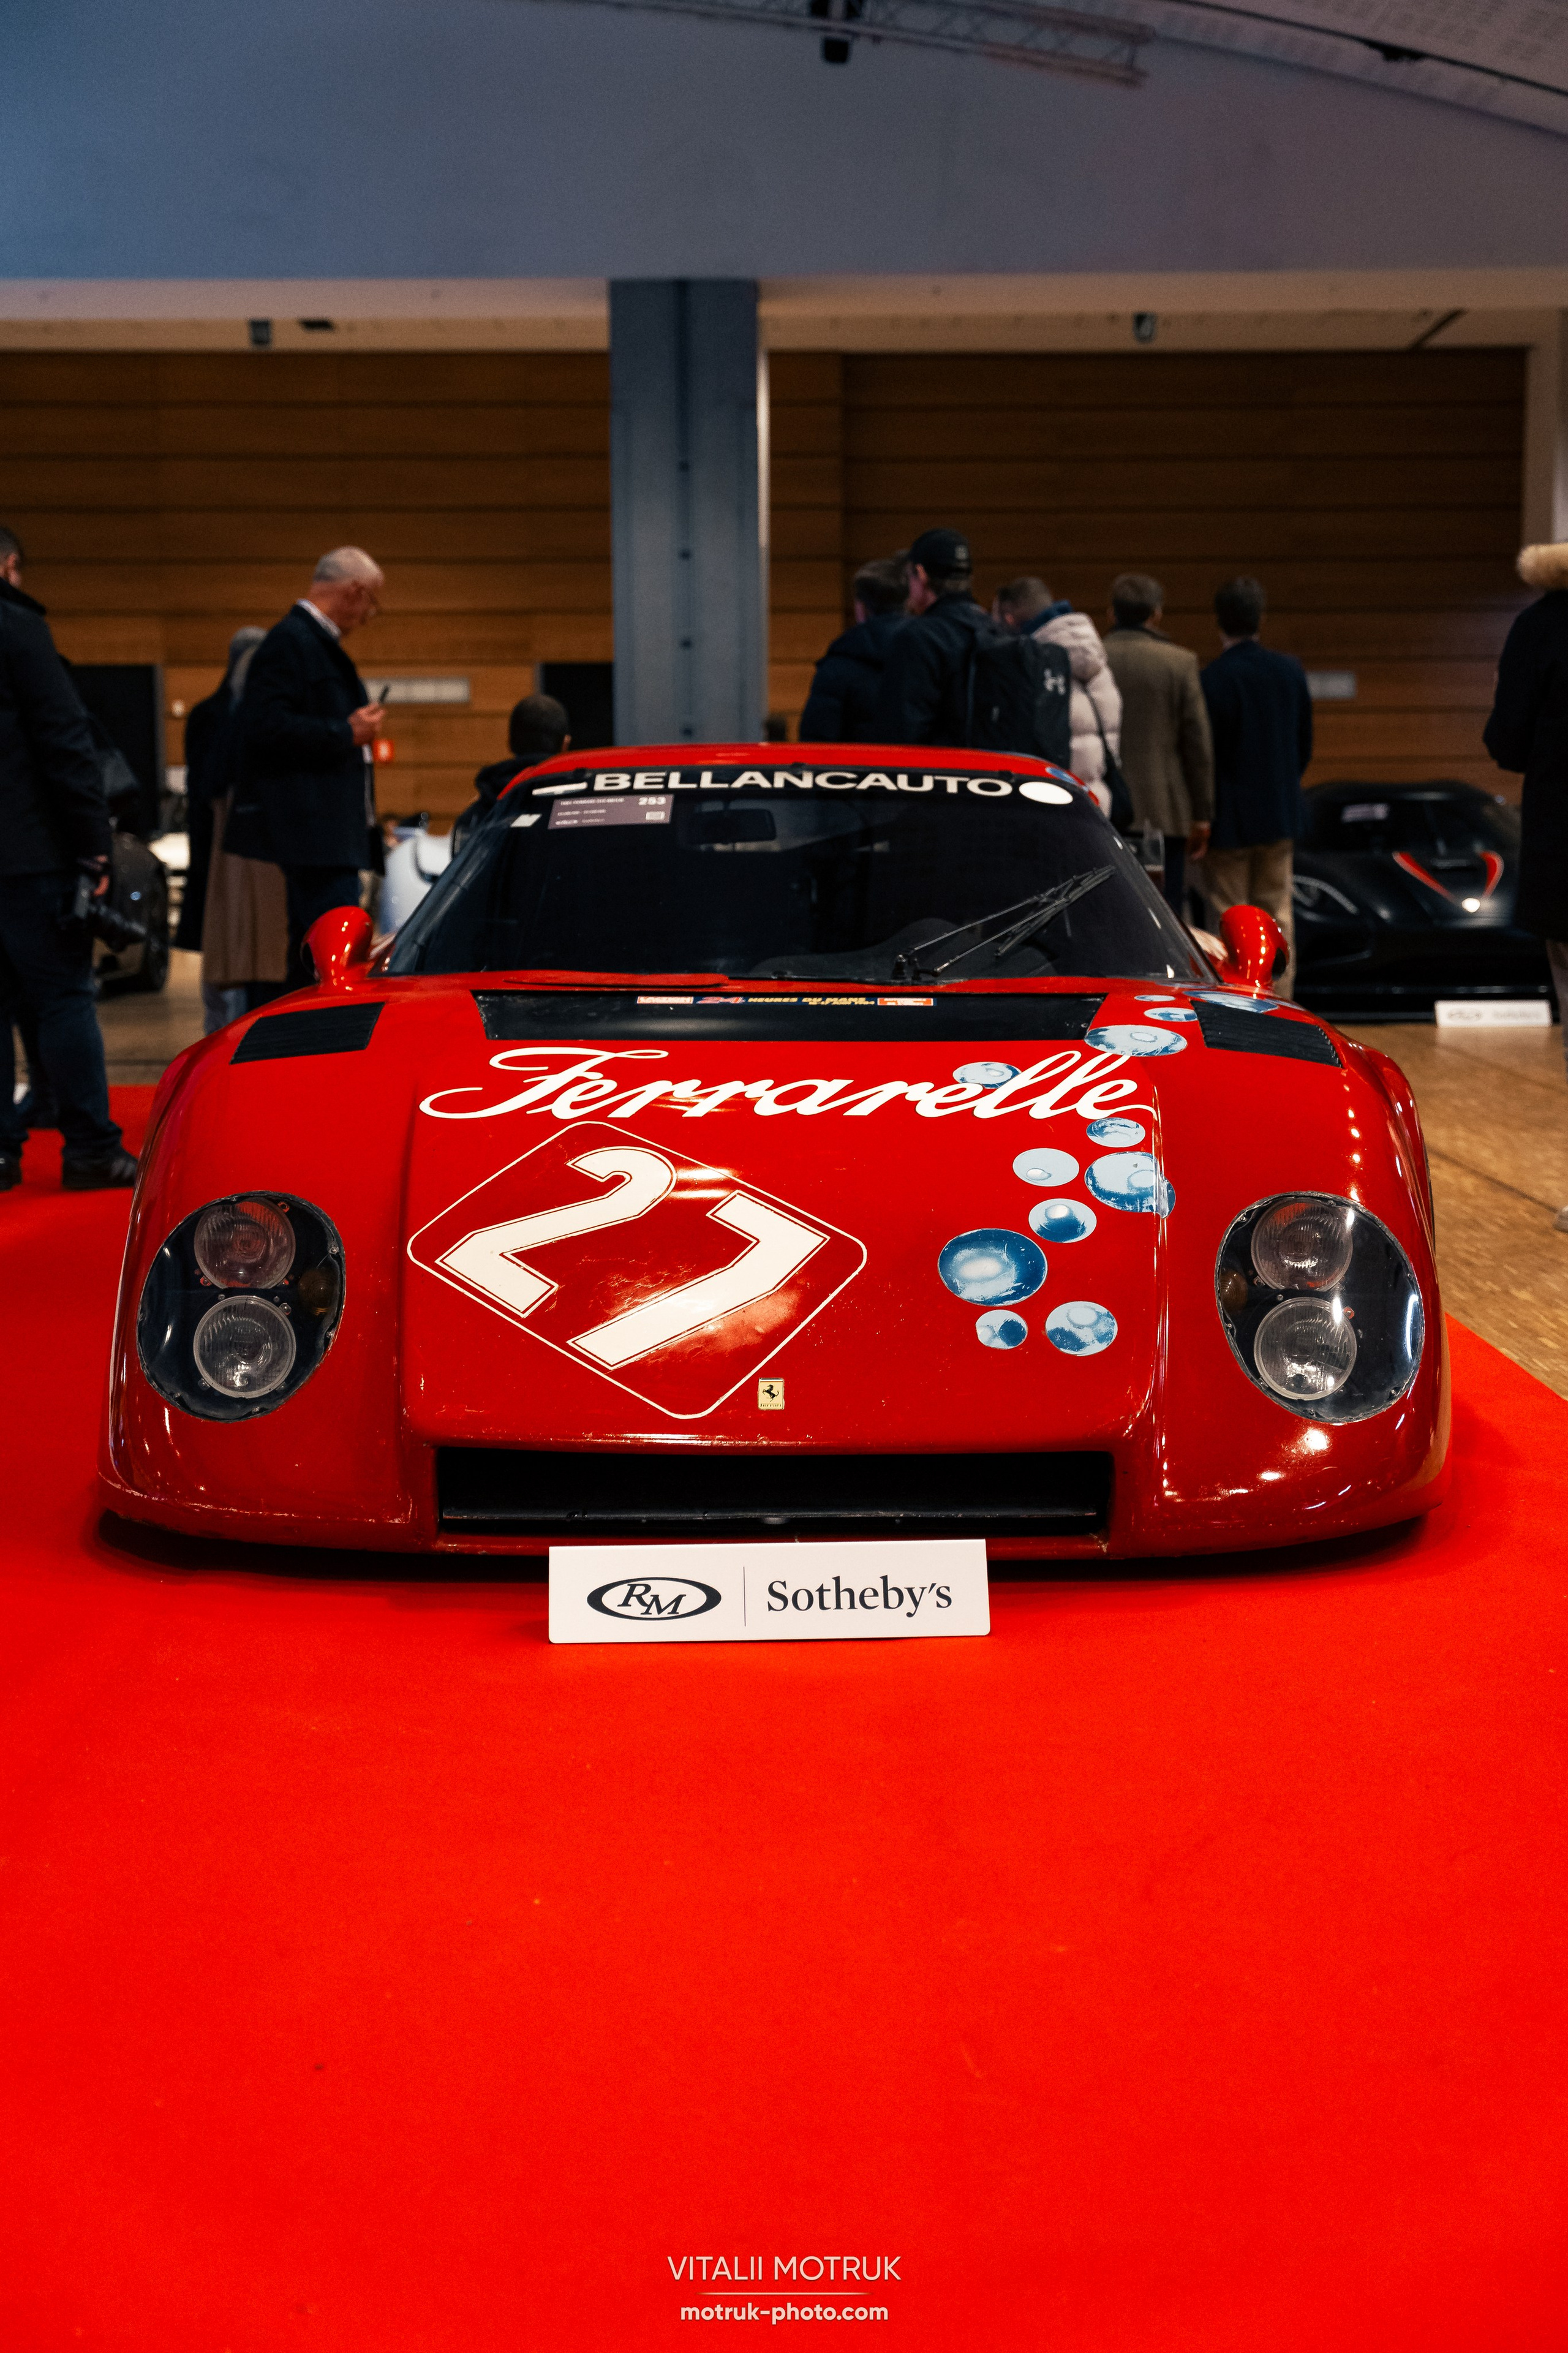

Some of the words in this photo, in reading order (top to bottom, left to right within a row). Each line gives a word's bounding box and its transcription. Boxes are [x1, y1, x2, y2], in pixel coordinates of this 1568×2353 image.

[593, 770, 1013, 796] BELLANCAUTO
[638, 796, 666, 806] 253
[419, 1046, 1158, 1121] Ferrarelle
[434, 1144, 831, 1371] 27
[617, 1583, 687, 1616] RM
[767, 1574, 953, 1618] Sotheby's
